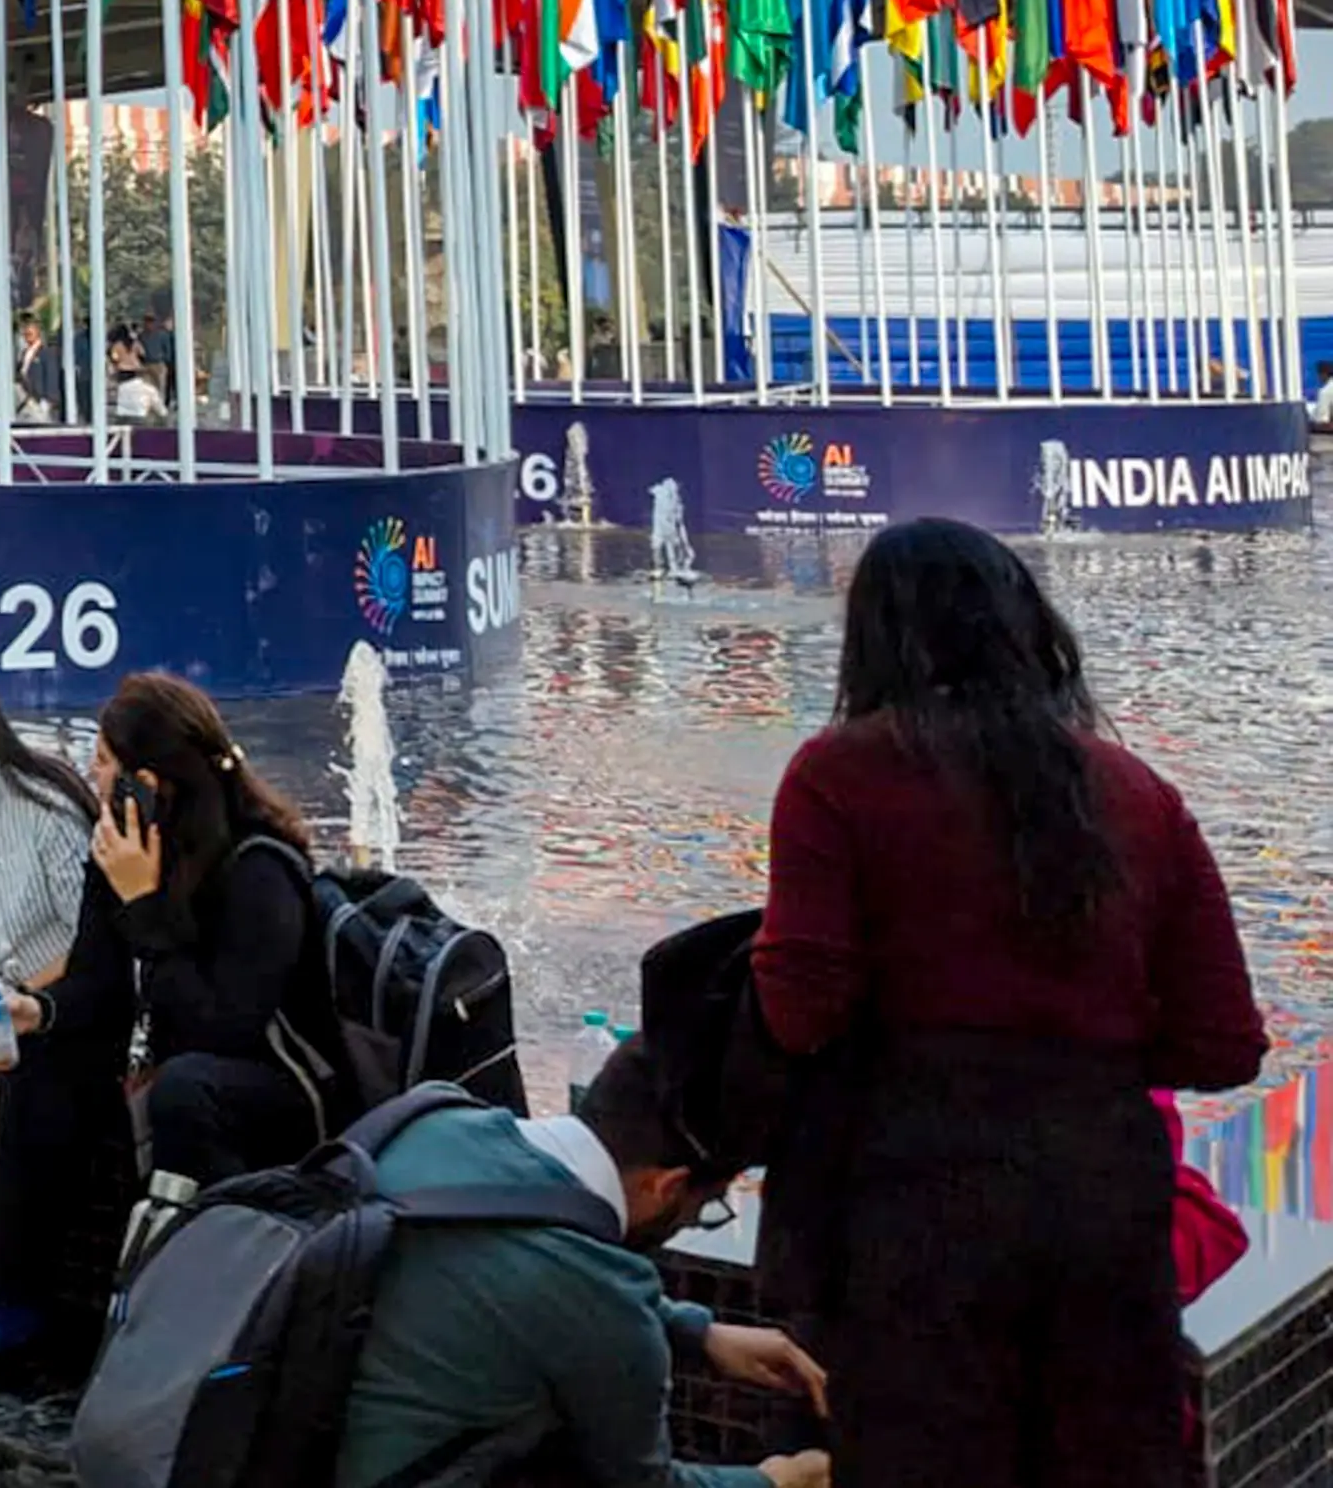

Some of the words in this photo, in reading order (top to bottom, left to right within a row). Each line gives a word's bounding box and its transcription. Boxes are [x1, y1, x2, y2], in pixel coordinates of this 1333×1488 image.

[823, 444, 851, 465] AI
[1069, 456, 1199, 508] INDIA
[1205, 454, 1242, 504] AI
[412, 536, 436, 570] AI
